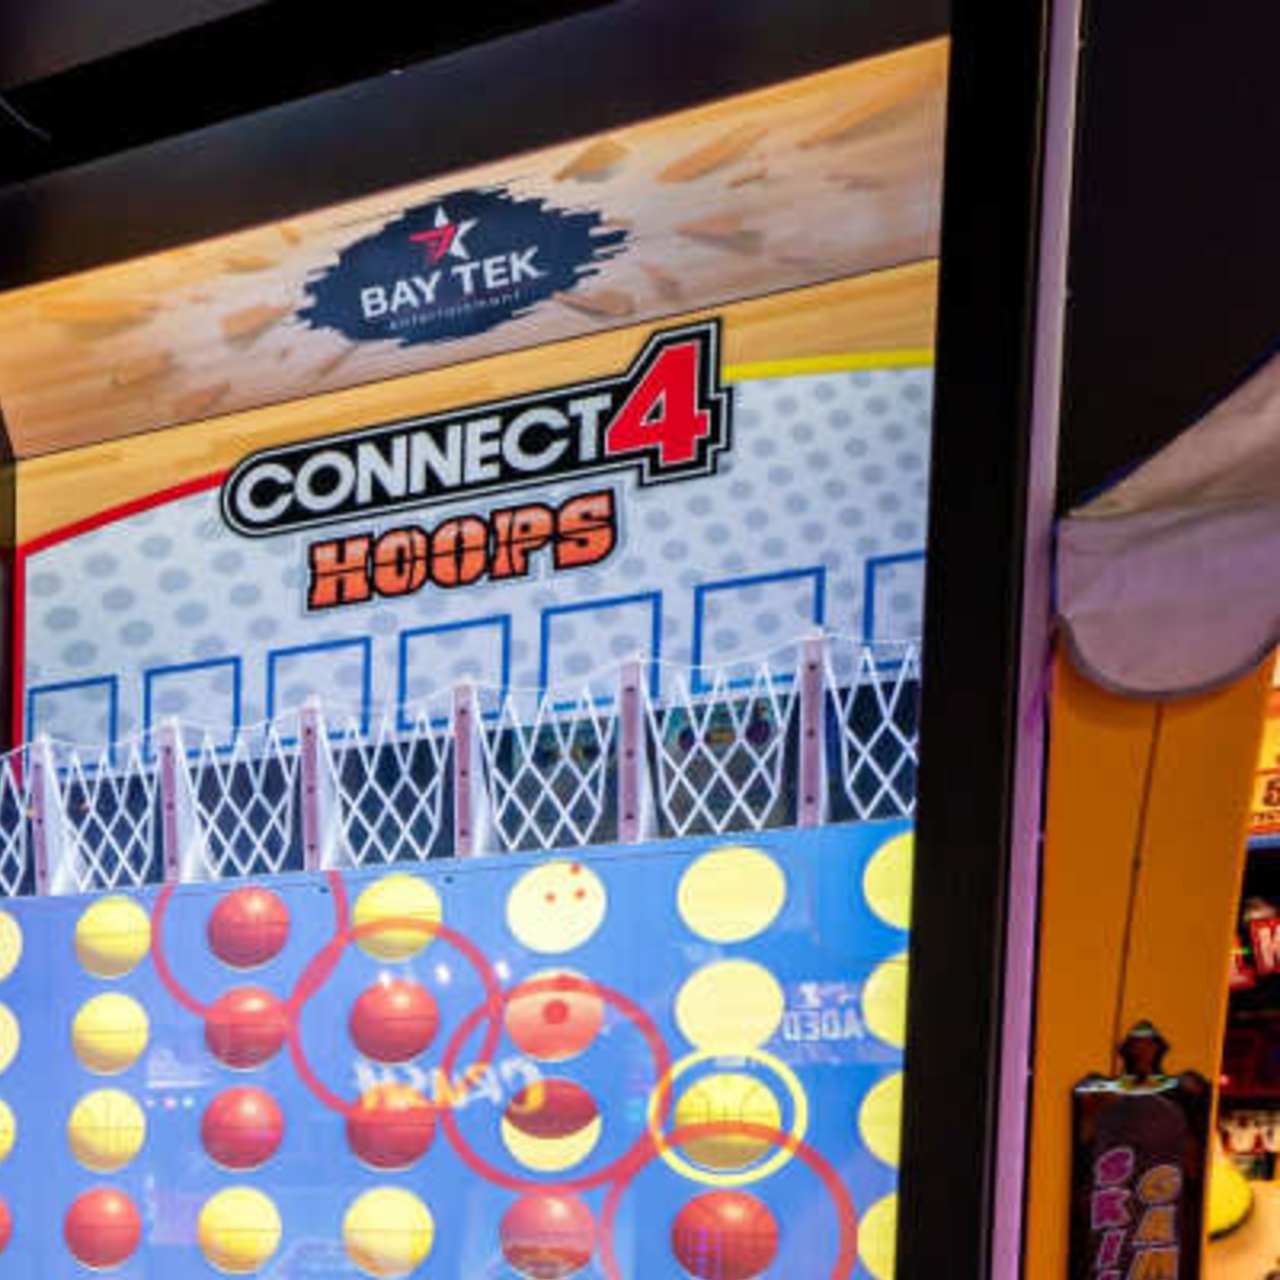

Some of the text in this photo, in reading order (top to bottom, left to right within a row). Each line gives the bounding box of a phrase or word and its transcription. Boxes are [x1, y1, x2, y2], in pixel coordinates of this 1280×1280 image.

[360, 245, 543, 319] BAY TEK
[237, 338, 711, 526] CONNECT 4
[307, 493, 616, 612] HOOPS
